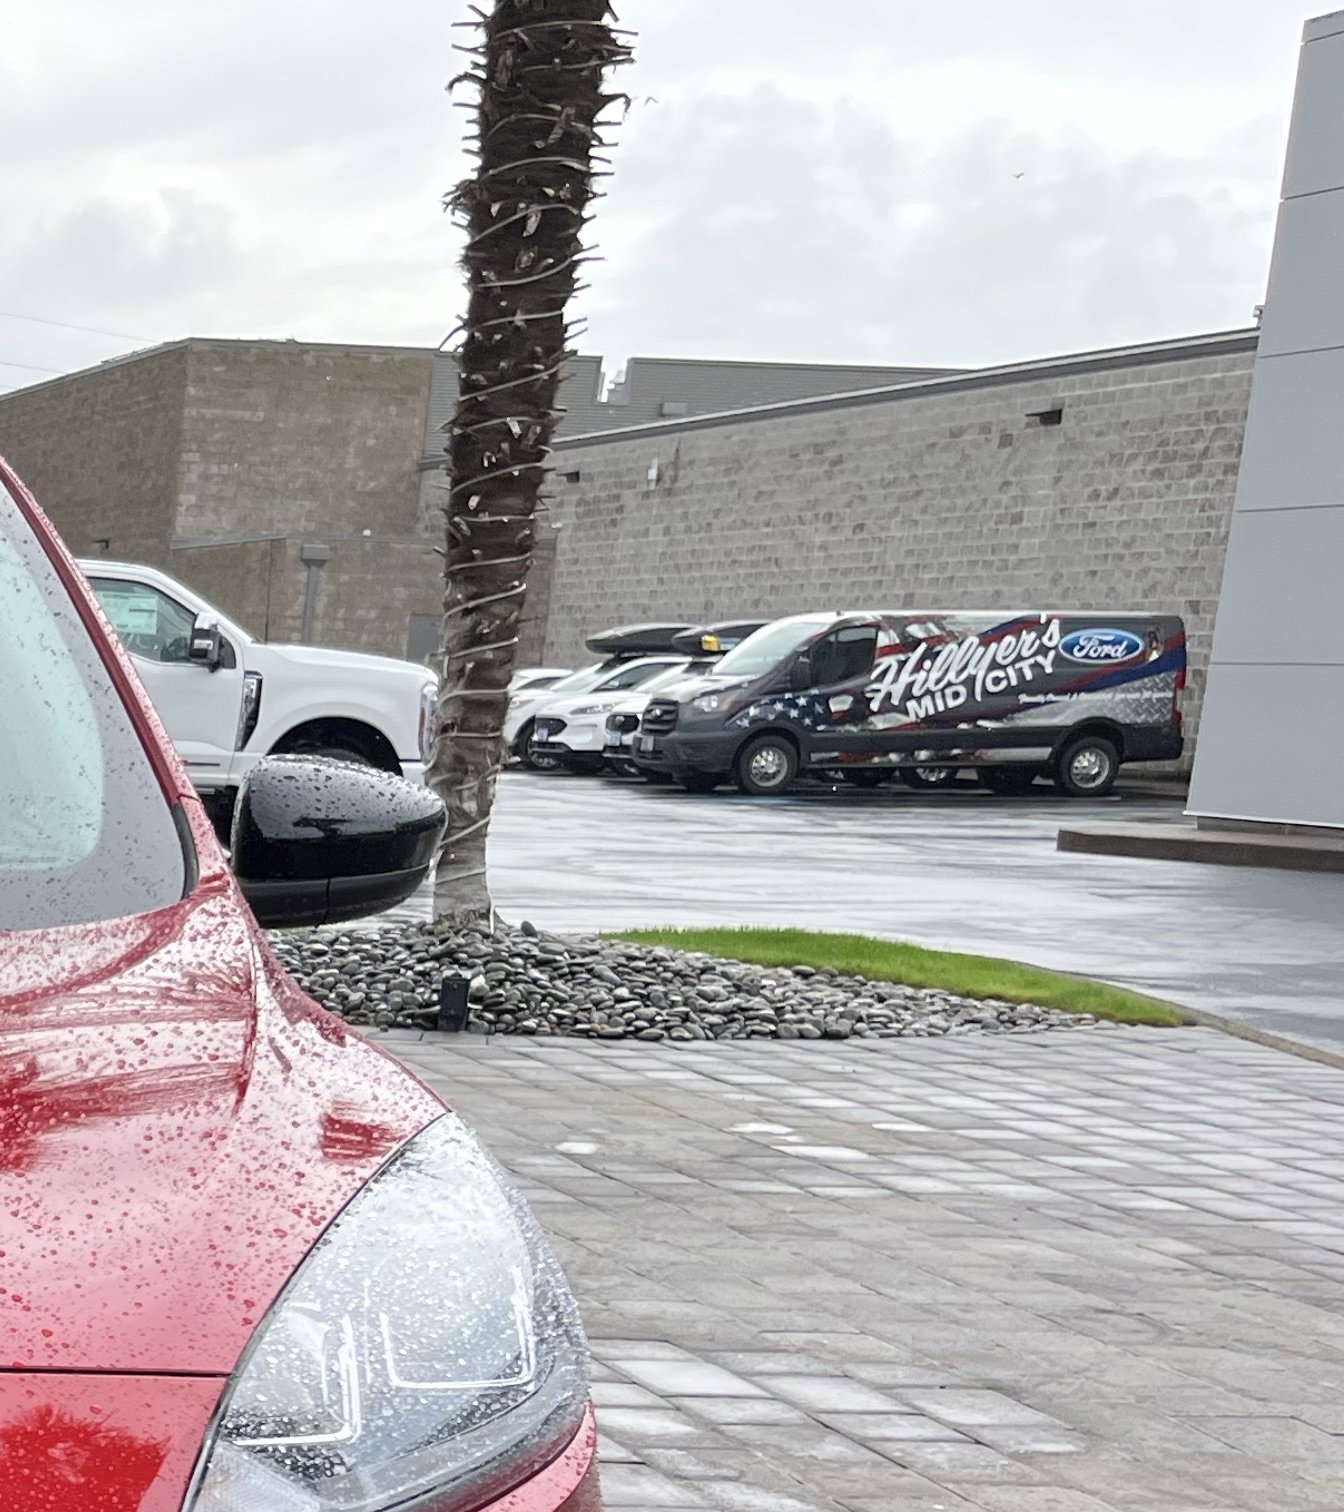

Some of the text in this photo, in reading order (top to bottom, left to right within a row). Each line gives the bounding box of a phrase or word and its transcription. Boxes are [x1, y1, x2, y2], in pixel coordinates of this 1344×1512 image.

[865, 612, 1126, 712] Hillyer's Ford
[906, 651, 1057, 722] MID CITY
